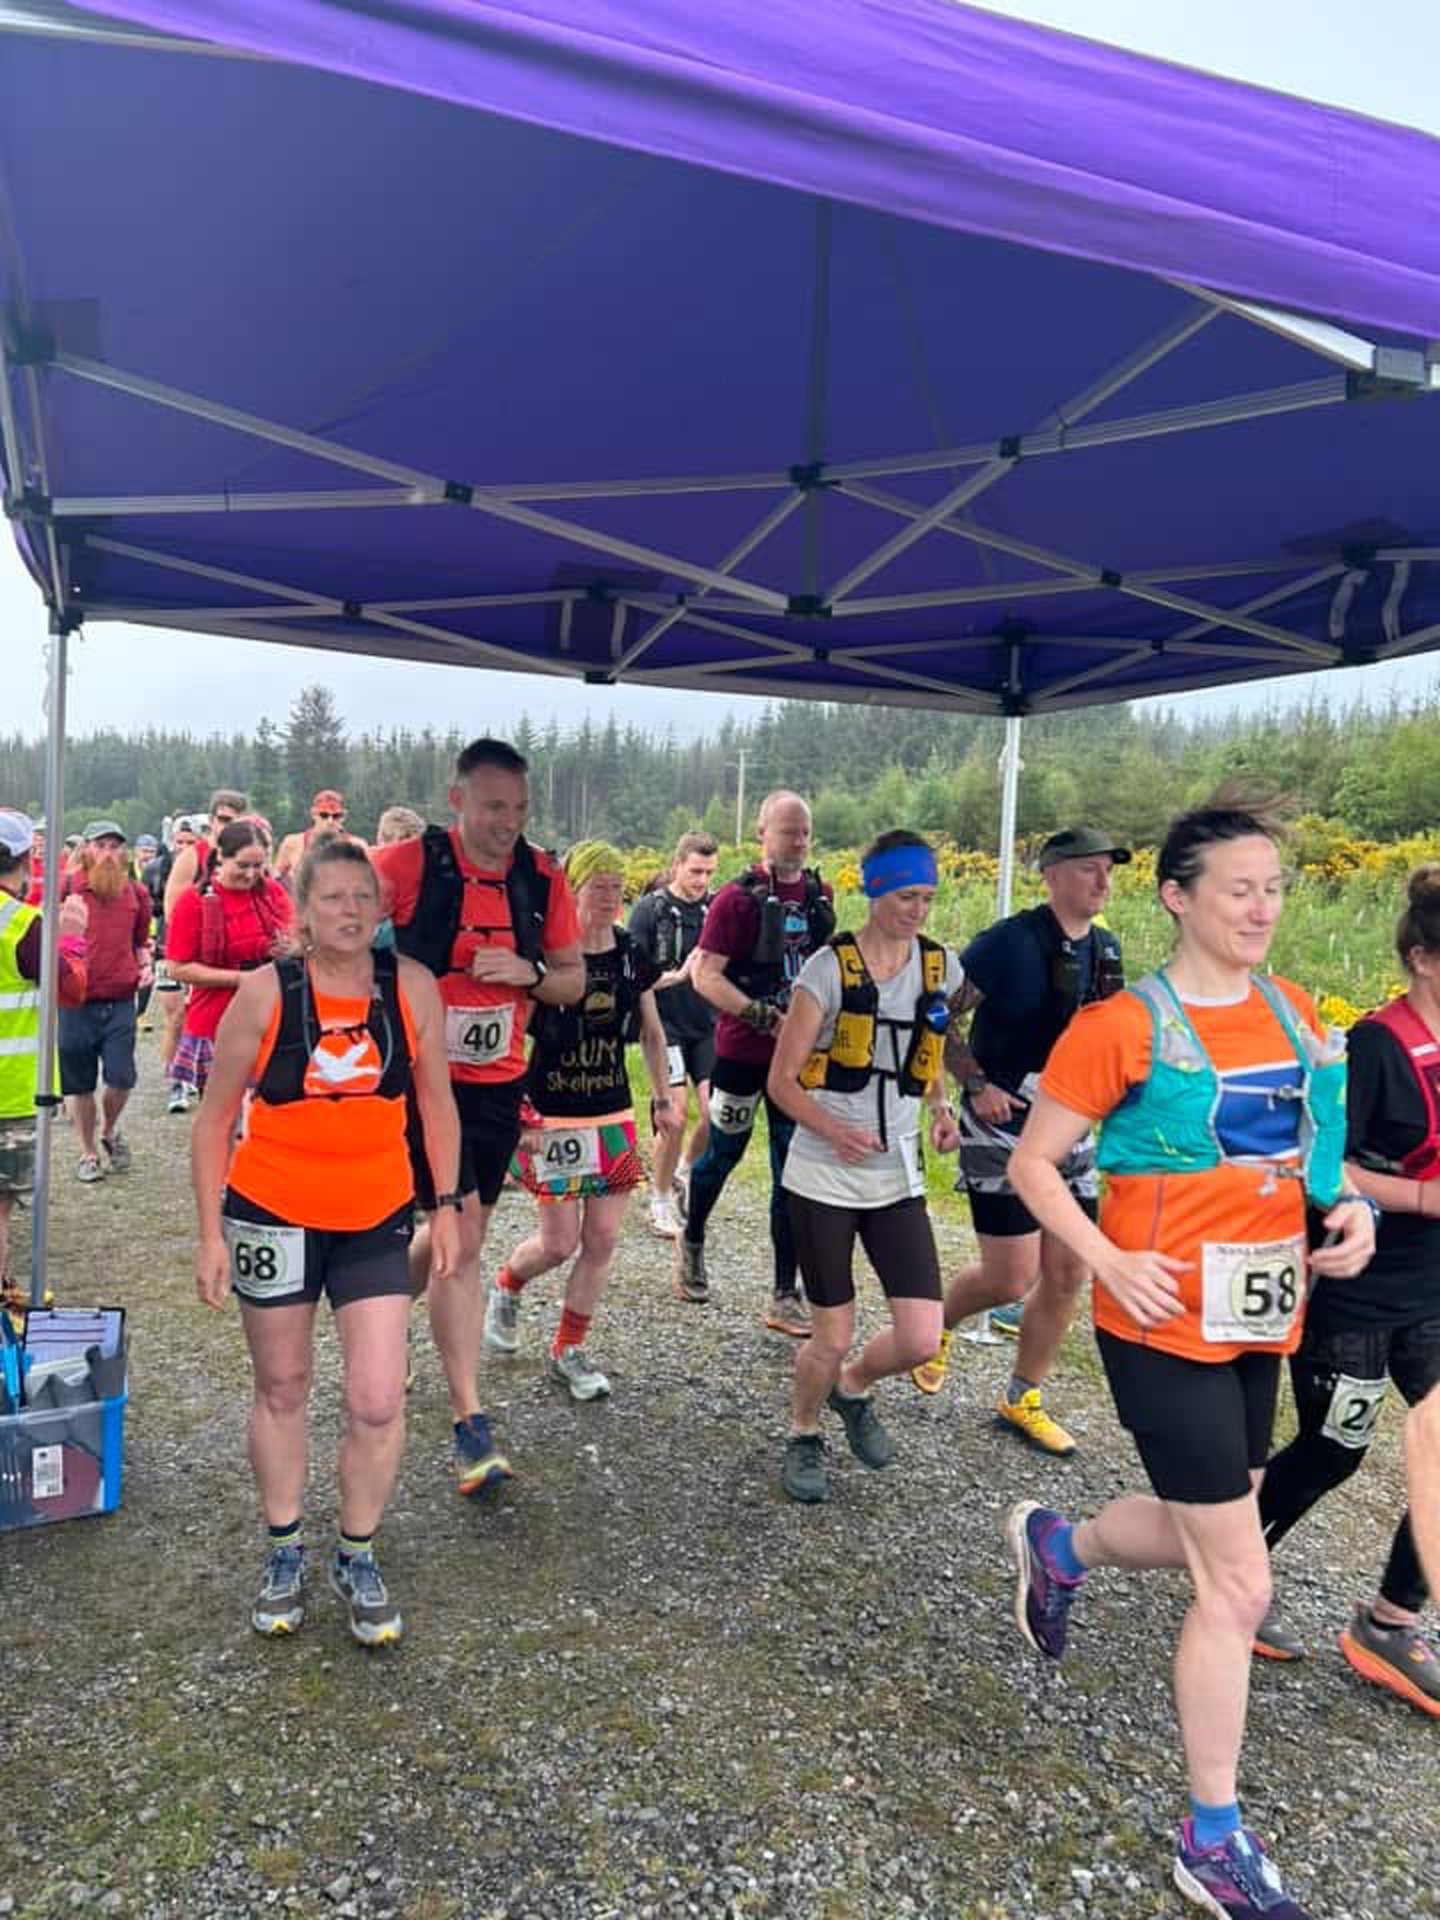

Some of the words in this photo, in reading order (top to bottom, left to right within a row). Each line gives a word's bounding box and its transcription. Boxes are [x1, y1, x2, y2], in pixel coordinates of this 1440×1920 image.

[463, 1022, 501, 1051] 40
[720, 1104, 751, 1124] 30
[546, 1138, 582, 1166] 49
[235, 1241, 277, 1280] 68
[1242, 1265, 1297, 1316] 58
